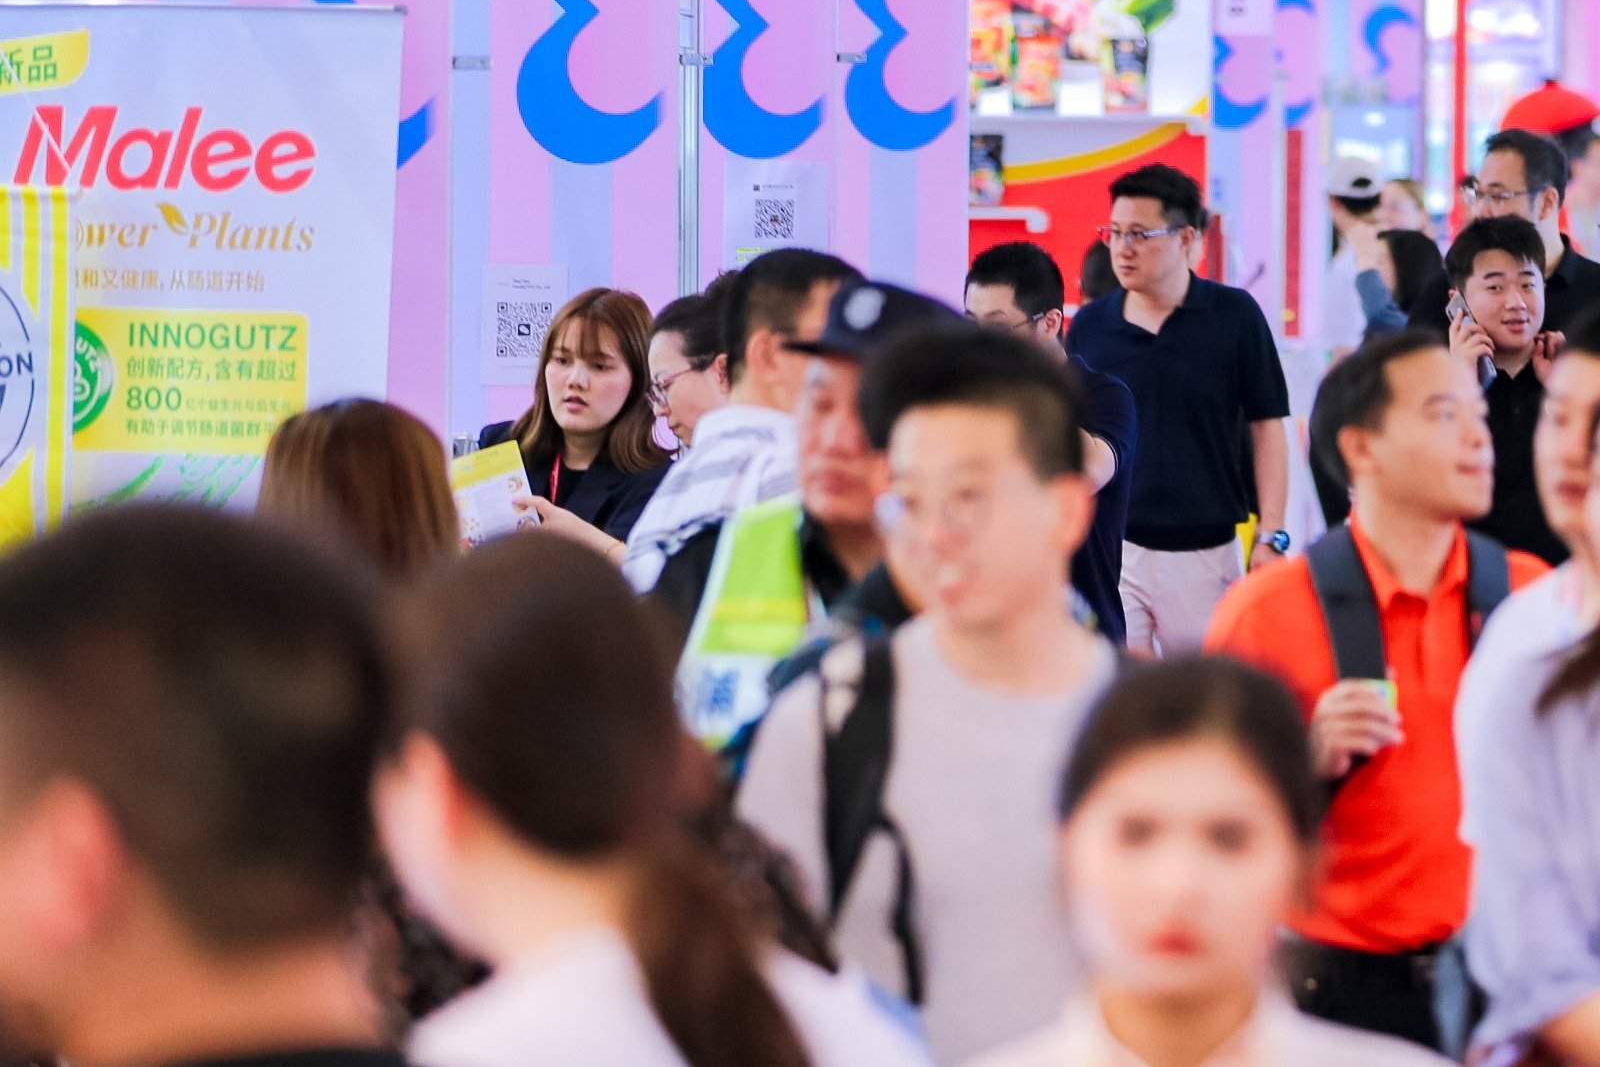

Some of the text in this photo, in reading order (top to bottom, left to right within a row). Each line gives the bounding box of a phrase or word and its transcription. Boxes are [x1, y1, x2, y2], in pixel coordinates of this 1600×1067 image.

[13, 106, 317, 193] Malee
[77, 212, 316, 251] wer Plants
[128, 322, 298, 352] INNOGUTZ
[126, 387, 182, 412] 800
